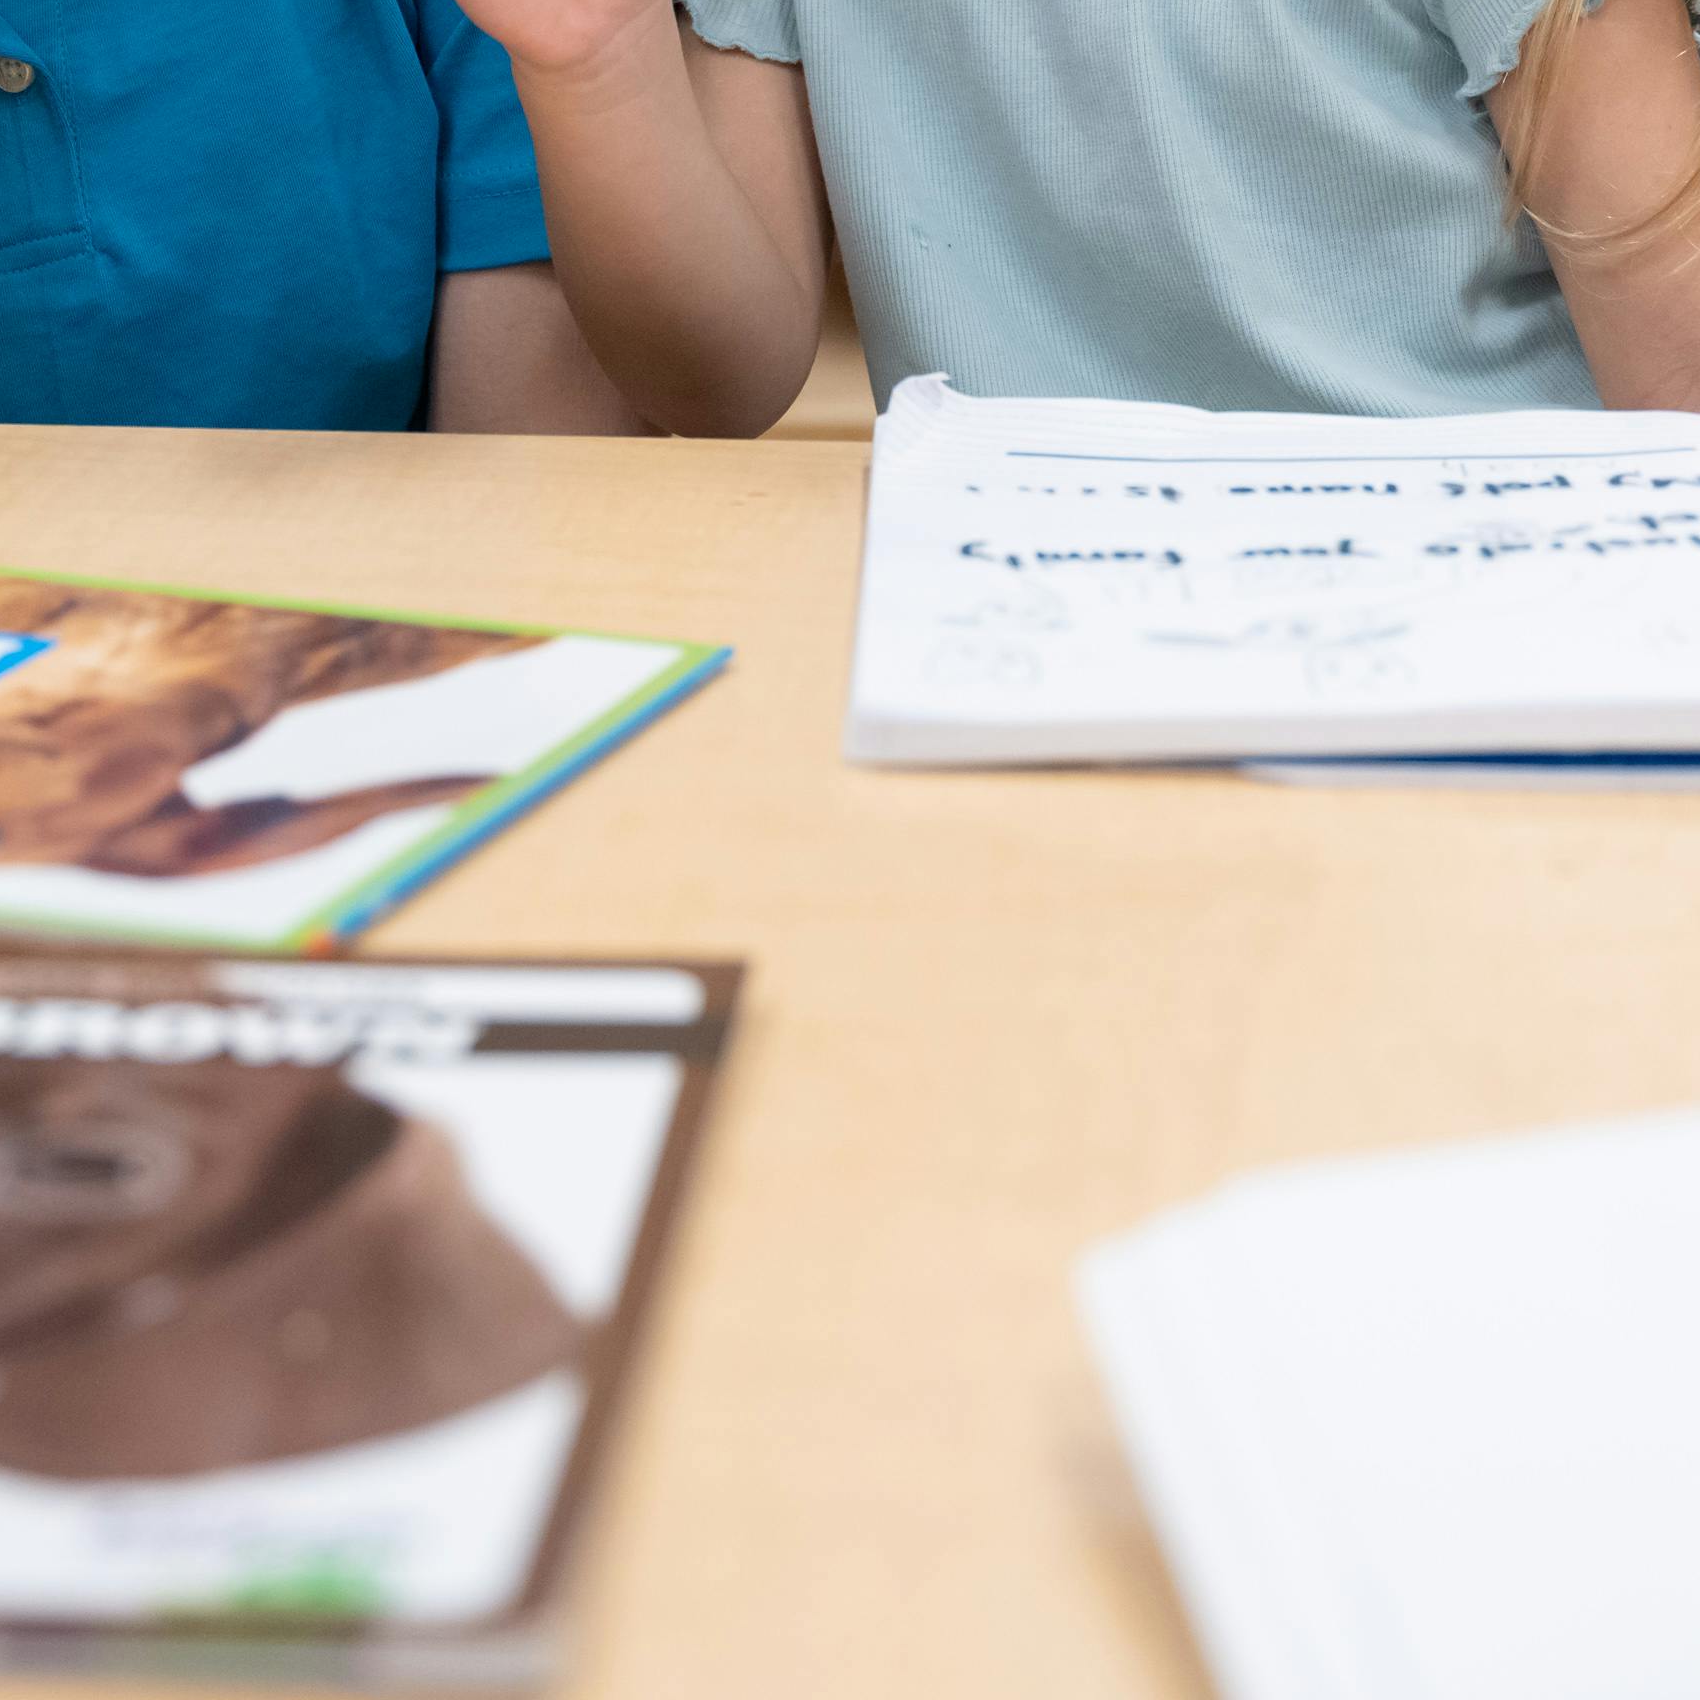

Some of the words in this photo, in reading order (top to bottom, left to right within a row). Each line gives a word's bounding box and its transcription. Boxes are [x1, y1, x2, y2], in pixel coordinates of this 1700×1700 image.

[1224, 483, 1400, 497] name
[958, 543, 1180, 570] family
[1238, 539, 1374, 559] your
